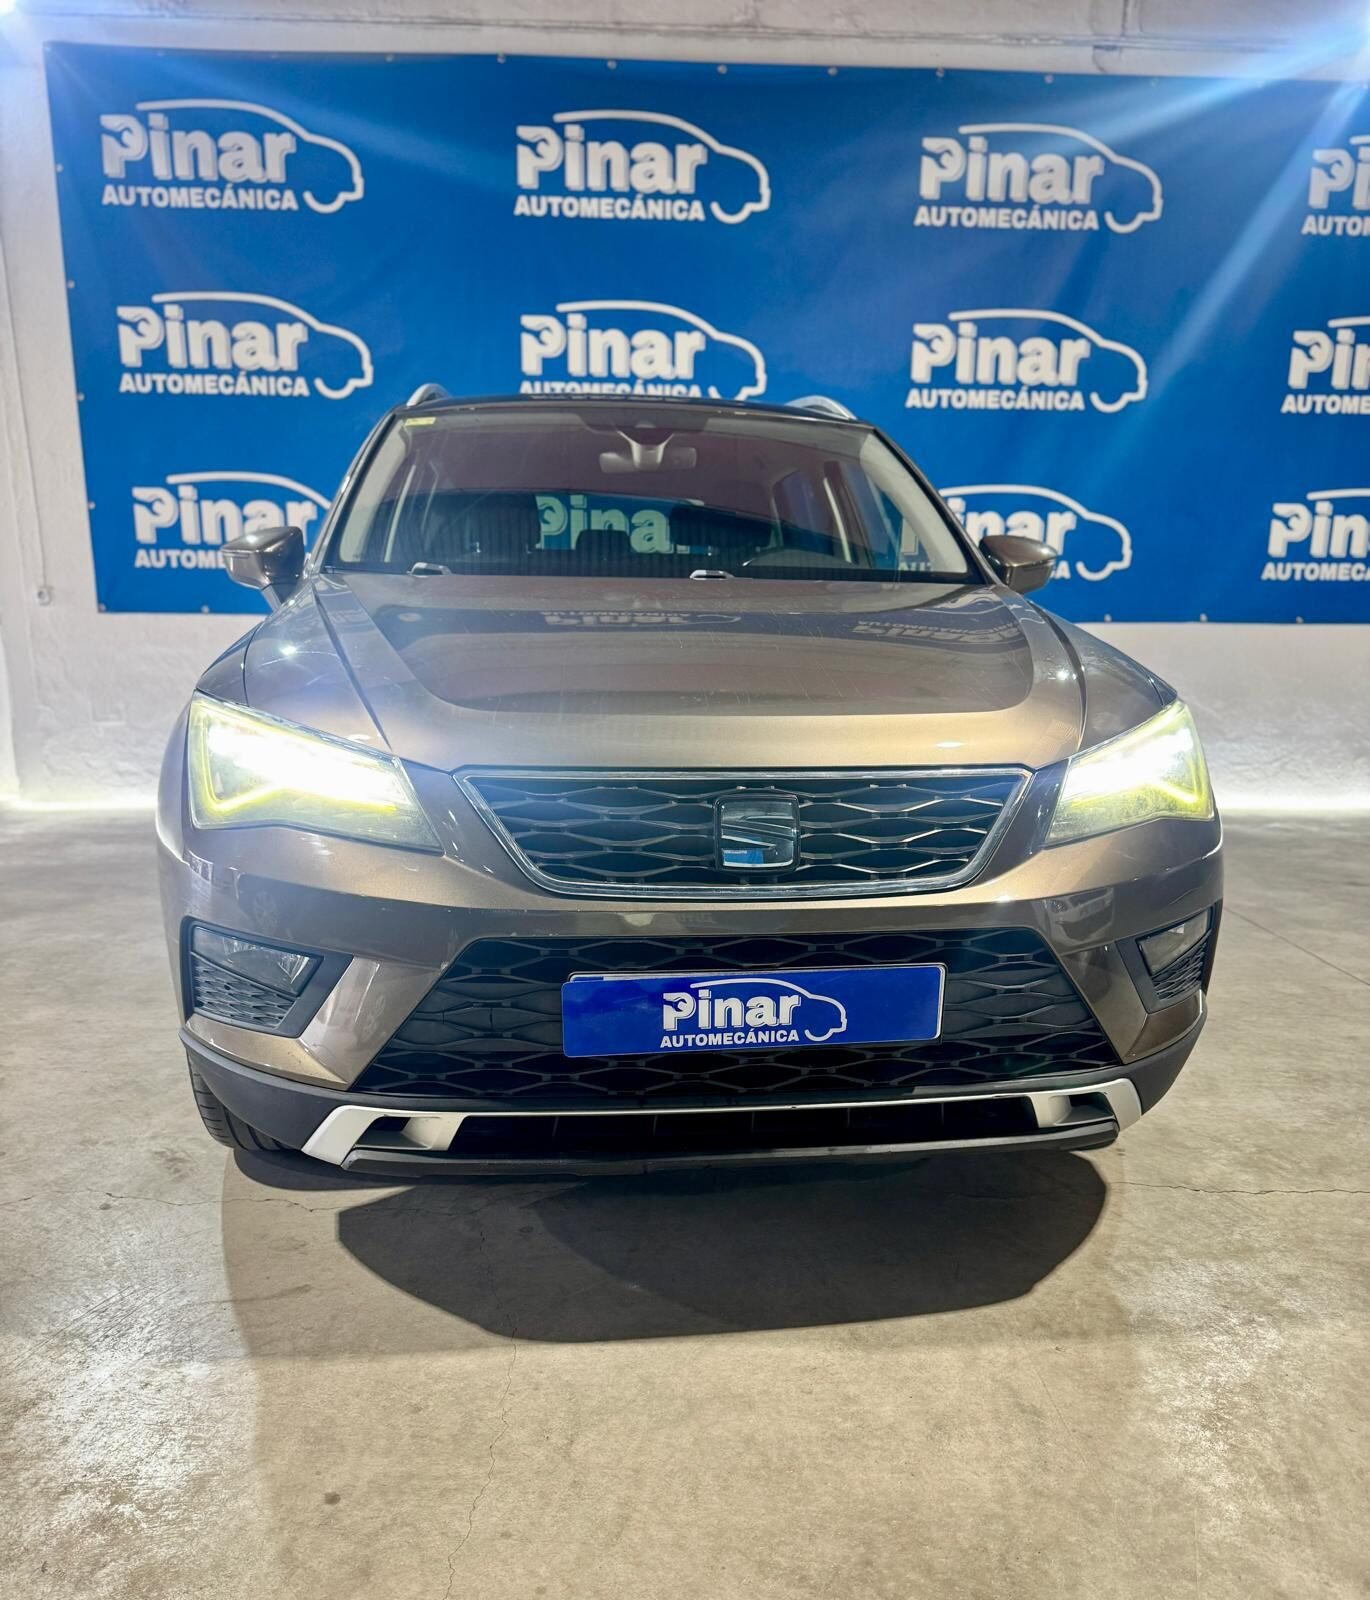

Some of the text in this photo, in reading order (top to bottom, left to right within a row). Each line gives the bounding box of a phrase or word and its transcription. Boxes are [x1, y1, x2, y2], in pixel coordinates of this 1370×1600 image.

[100, 112, 296, 183] Pinar
[516, 124, 708, 194] Pinar
[919, 136, 1105, 205] Pinar
[102, 184, 298, 211] AUTOMECÁNICA
[514, 194, 706, 221] AUTOMECÁNICA
[913, 205, 1100, 231] AUTOMECÁNICA
[116, 304, 309, 371] Pinar
[520, 313, 707, 380] Pinar
[911, 322, 1091, 387] Pinar
[119, 371, 310, 397] AUTOMECÁNICA
[905, 384, 1085, 411] AUTOMECÁNICA
[1267, 500, 1370, 559] Pin
[663, 989, 801, 1031] Pinar
[660, 1028, 800, 1049] AUTOMECÁNICA
